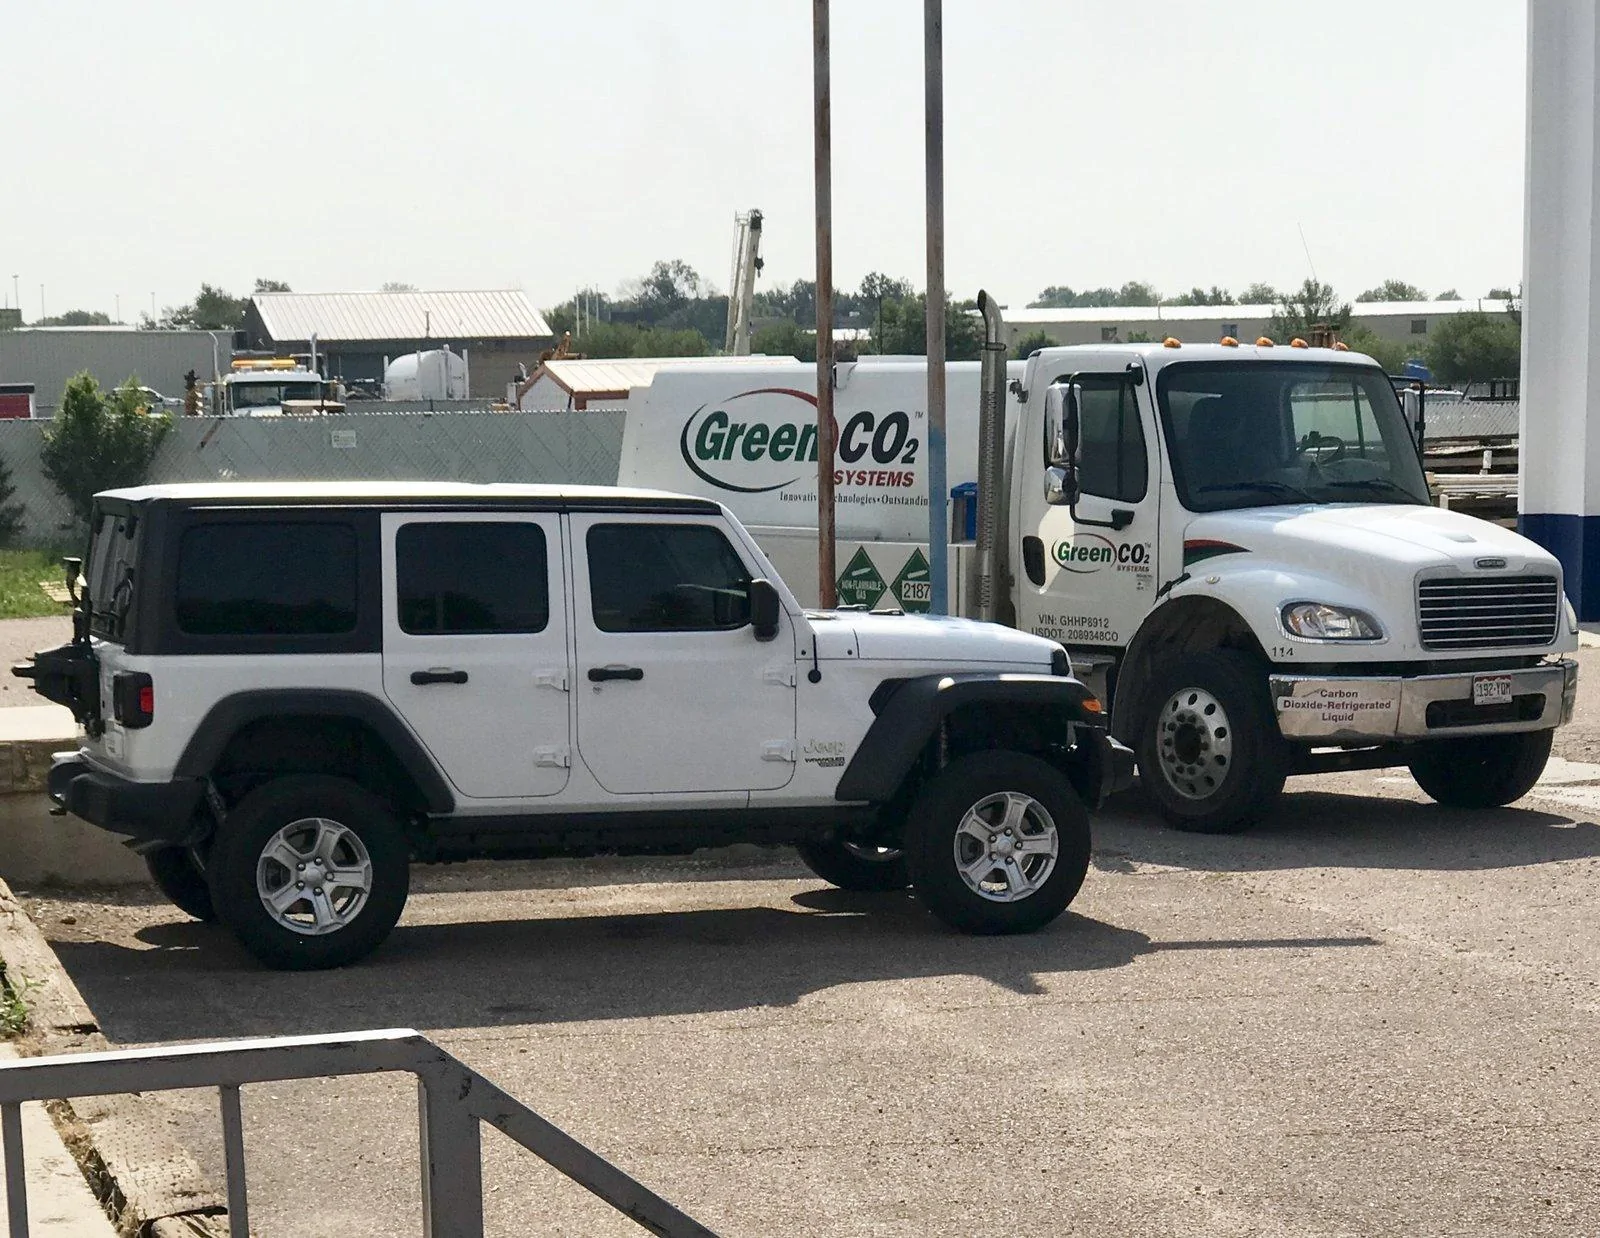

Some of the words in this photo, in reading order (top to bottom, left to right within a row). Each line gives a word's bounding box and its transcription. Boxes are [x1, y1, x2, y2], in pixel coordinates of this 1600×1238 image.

[695, 410, 818, 462] Green
[833, 470, 914, 487] SYSTEMS
[780, 490, 816, 502] Innovativ
[1057, 541, 1112, 563] Green
[903, 583, 931, 599] 2187
[1038, 614, 1057, 625] VIN:
[1271, 647, 1294, 657] 114
[1320, 690, 1358, 698] Carbon
[1283, 700, 1391, 711] Dioxide-Refrigerated
[1322, 713, 1354, 722] Liquid
